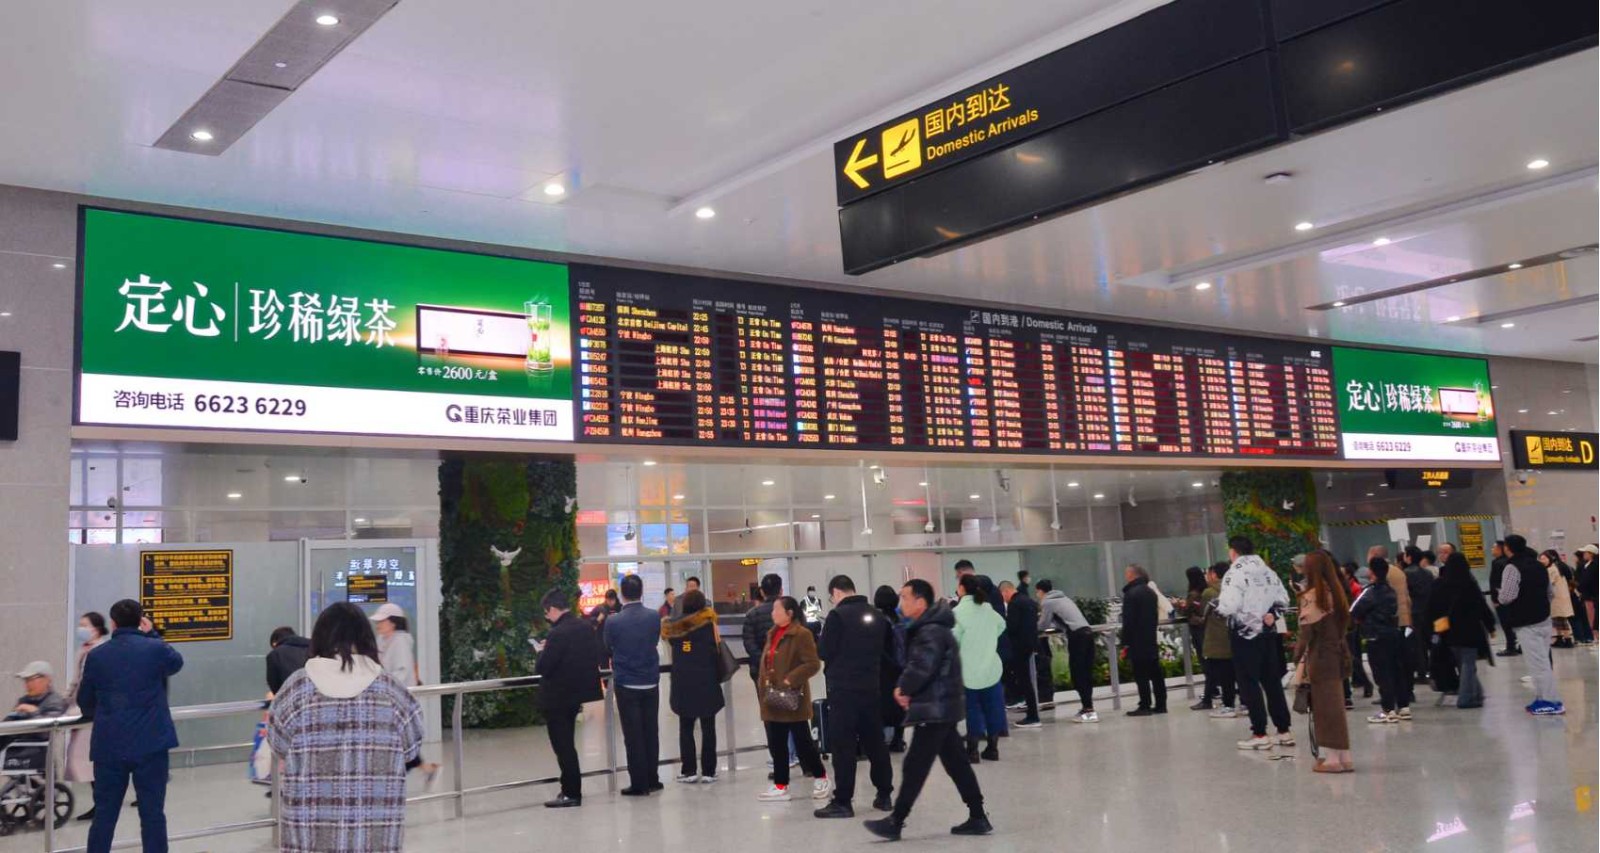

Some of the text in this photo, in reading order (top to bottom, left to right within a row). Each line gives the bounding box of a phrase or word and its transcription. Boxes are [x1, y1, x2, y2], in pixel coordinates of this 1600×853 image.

[925, 84, 1012, 139] 国内到达
[927, 109, 1039, 160] Domestic Arrivals
[114, 274, 398, 349] 定心 珍稀绿茶
[982, 312, 1018, 328] 国内到港
[1026, 317, 1064, 330] Domestic
[1068, 322, 1098, 334] Arrivals
[114, 390, 307, 416] 咨询电话 6623 6229
[1346, 380, 1434, 413] 定心 珍稀绿茶
[465, 406, 557, 427] 重庆茶业集团
[1580, 441, 1593, 464] D
